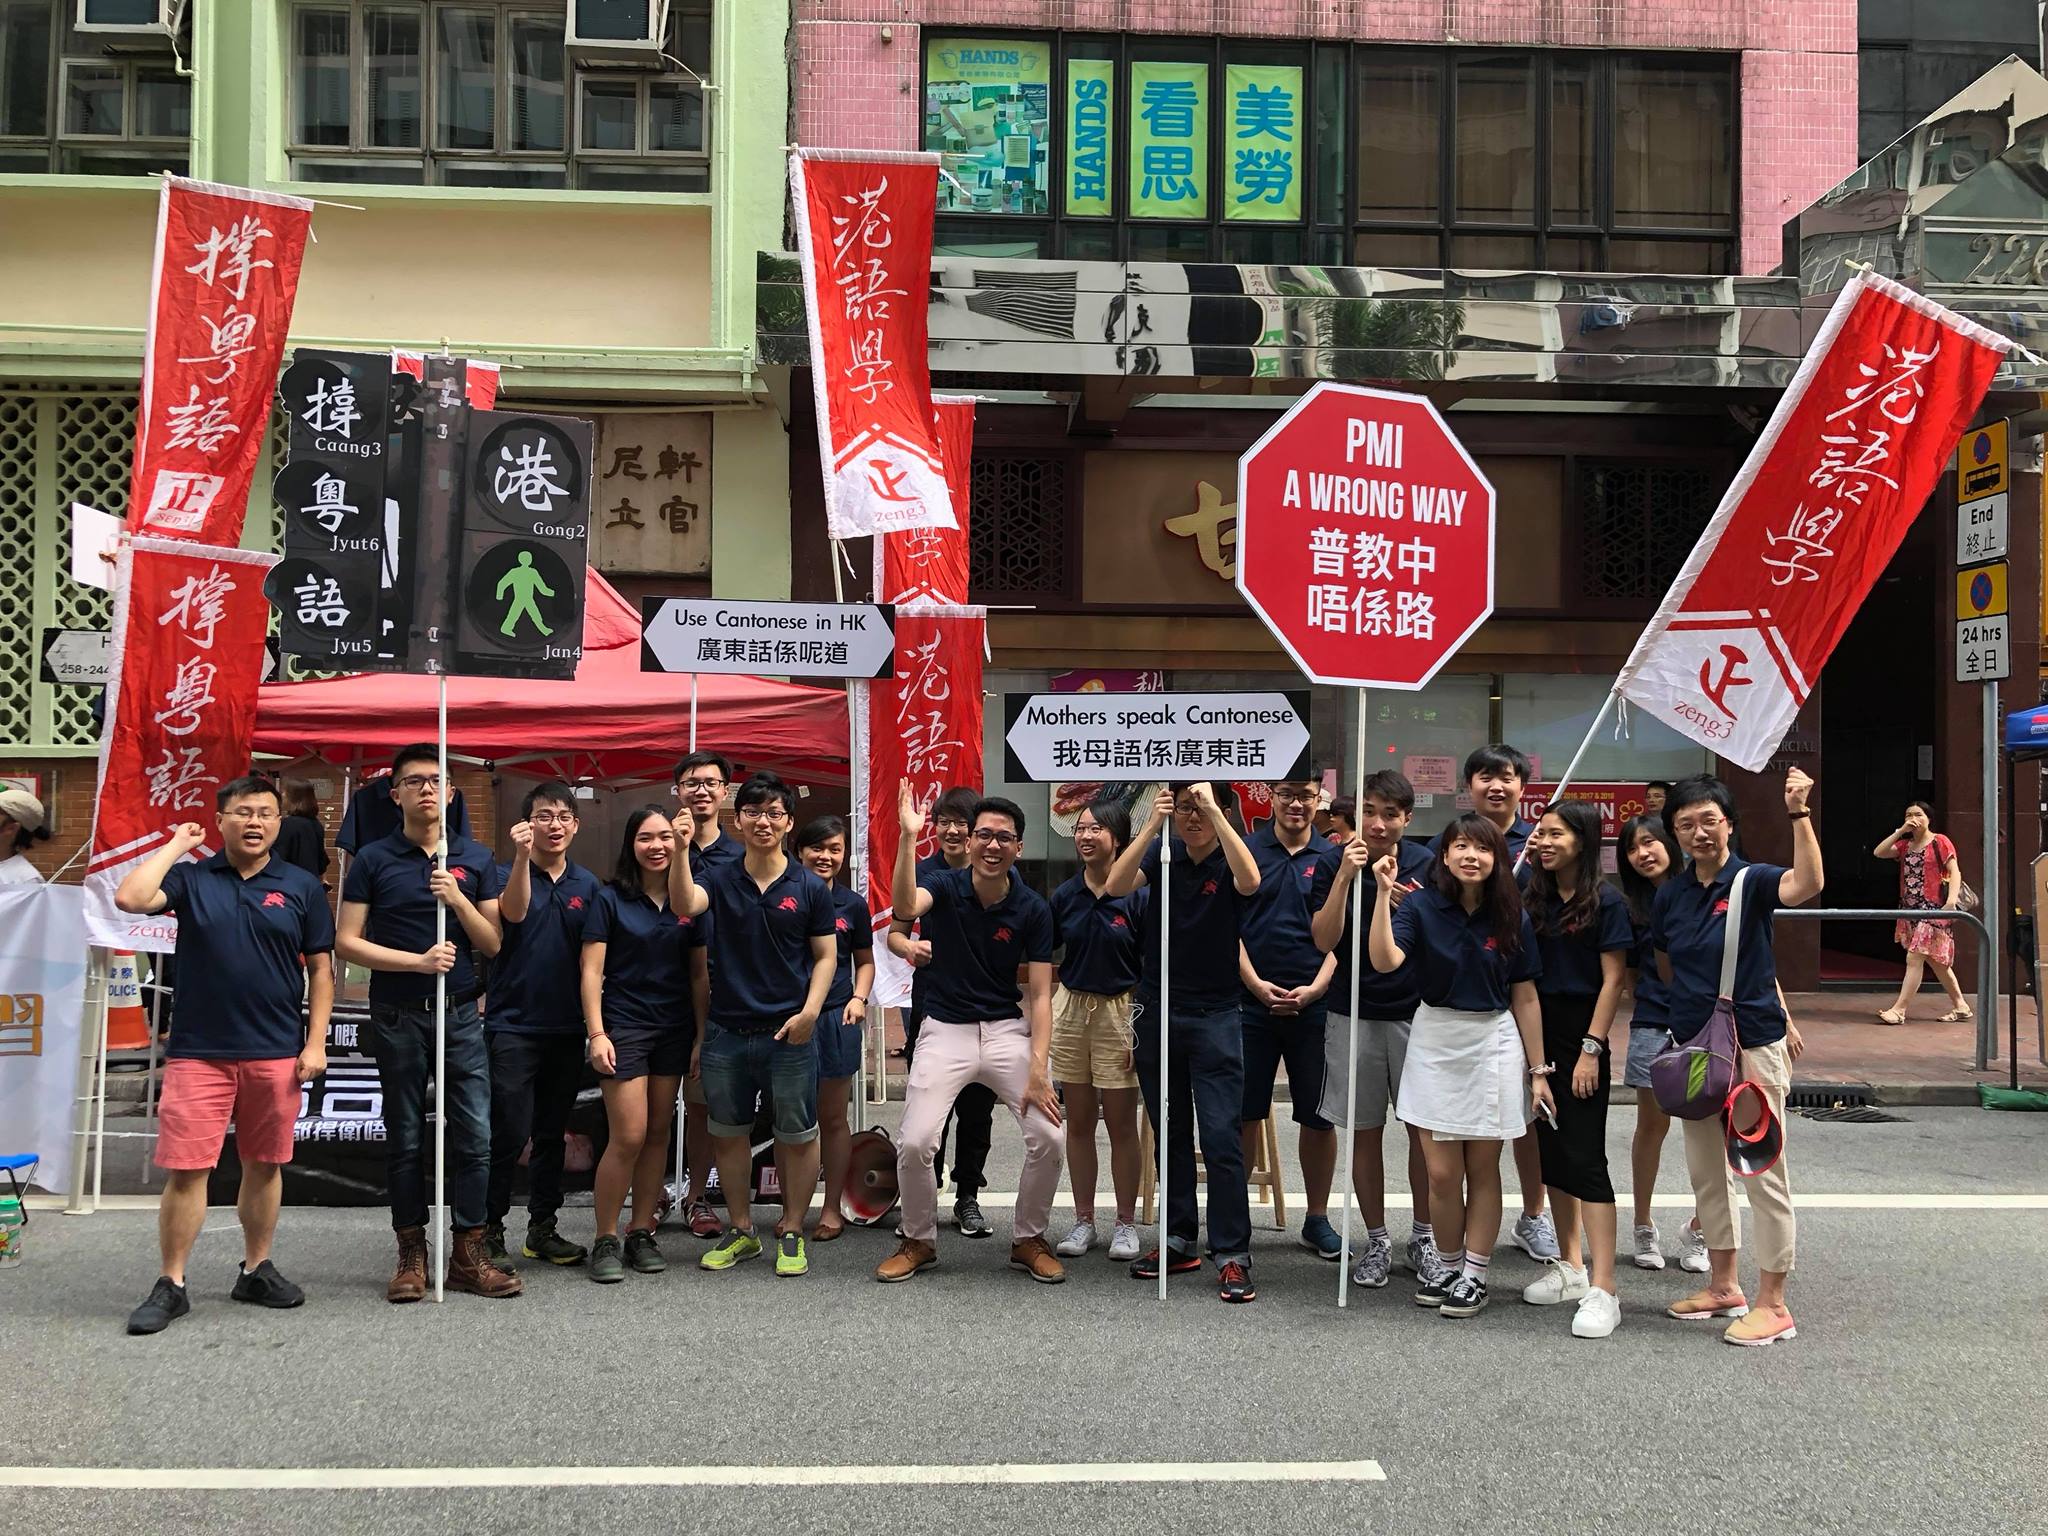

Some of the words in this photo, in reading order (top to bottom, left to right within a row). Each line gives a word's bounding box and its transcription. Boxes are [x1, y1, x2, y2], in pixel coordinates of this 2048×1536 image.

[959, 49, 1019, 65] HANDS
[1074, 78, 1108, 201] HANDS
[1141, 80, 1199, 201] 看思
[1235, 84, 1294, 204] 美勞
[301, 377, 361, 438] 撐
[315, 438, 382, 458] Caang3
[1346, 417, 1403, 469] PMI
[494, 437, 570, 512] 港
[867, 459, 922, 502] 正
[1282, 469, 1302, 509] A
[1308, 472, 1404, 520] WRONG
[1411, 486, 1467, 527] WAY
[874, 501, 927, 523] zeng3
[1971, 504, 1994, 526] End
[329, 535, 380, 552] Jyut6
[533, 522, 586, 540] Gong2
[1965, 528, 1997, 556] 終止
[1308, 527, 1436, 585] 普教中
[294, 573, 350, 627] 語
[1307, 584, 1436, 641] 唔係路
[675, 609, 707, 627] Use
[715, 610, 808, 630] Cantonese
[816, 613, 831, 630] in
[840, 614, 866, 631] HK
[330, 638, 372, 654] Jyu5
[1962, 627, 1979, 644] 24
[1982, 625, 2002, 642] hrs
[543, 645, 583, 660] Jan4
[696, 638, 849, 664] 廣東話係呢道
[1965, 649, 1998, 674] 全日
[1026, 705, 1107, 725] Mothers
[1117, 704, 1176, 729] speak
[1186, 704, 1294, 725] Cantonese
[1673, 700, 1735, 739] zeng3
[1053, 738, 1266, 768] 我母語係廣東話
[128, 923, 178, 944] zeng
[108, 984, 137, 997] OLICE
